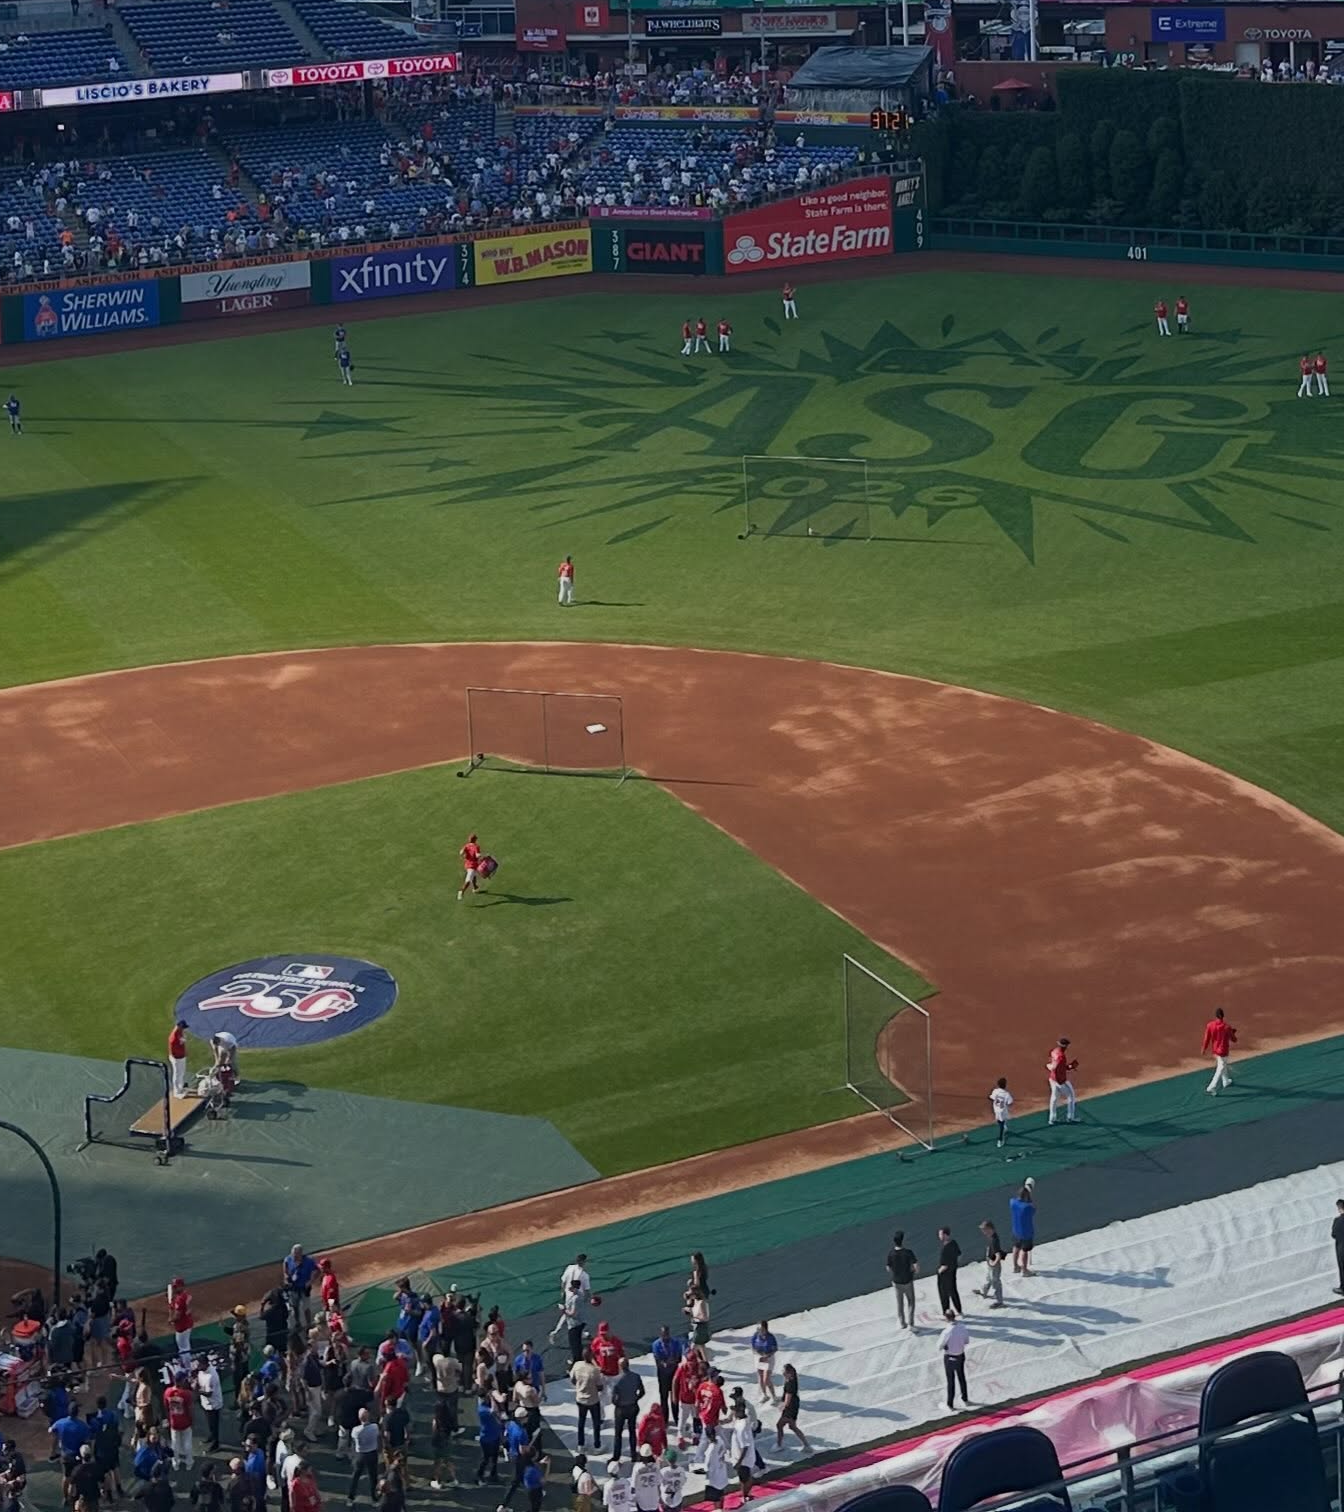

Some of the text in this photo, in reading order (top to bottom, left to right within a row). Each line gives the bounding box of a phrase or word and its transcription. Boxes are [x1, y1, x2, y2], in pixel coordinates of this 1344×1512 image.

[1175, 18, 1217, 29] Extreme
[1263, 29, 1312, 39] TOYOTA
[297, 64, 358, 83] TOYOTA
[394, 56, 452, 74] TOYOTA
[77, 77, 210, 102] LISCIO'S BAKERY
[800, 196, 818, 206] Like
[827, 194, 848, 205] good
[805, 209, 829, 219] State
[830, 206, 853, 216] Farm
[854, 205, 862, 213] is
[306, 244, 368, 259] ASPLUNDH
[628, 241, 704, 260] GIANT
[1127, 246, 1147, 260] 401
[232, 252, 295, 268] ASPLUNDH
[154, 262, 218, 276] ASPLUNDH
[340, 252, 447, 294] xfinity
[75, 271, 141, 287] ASPLUNDH
[207, 272, 285, 298] Yuengling
[62, 289, 145, 312] SHERWIN
[222, 295, 273, 313] LAGER
[572, 374, 1252, 480] ASG
